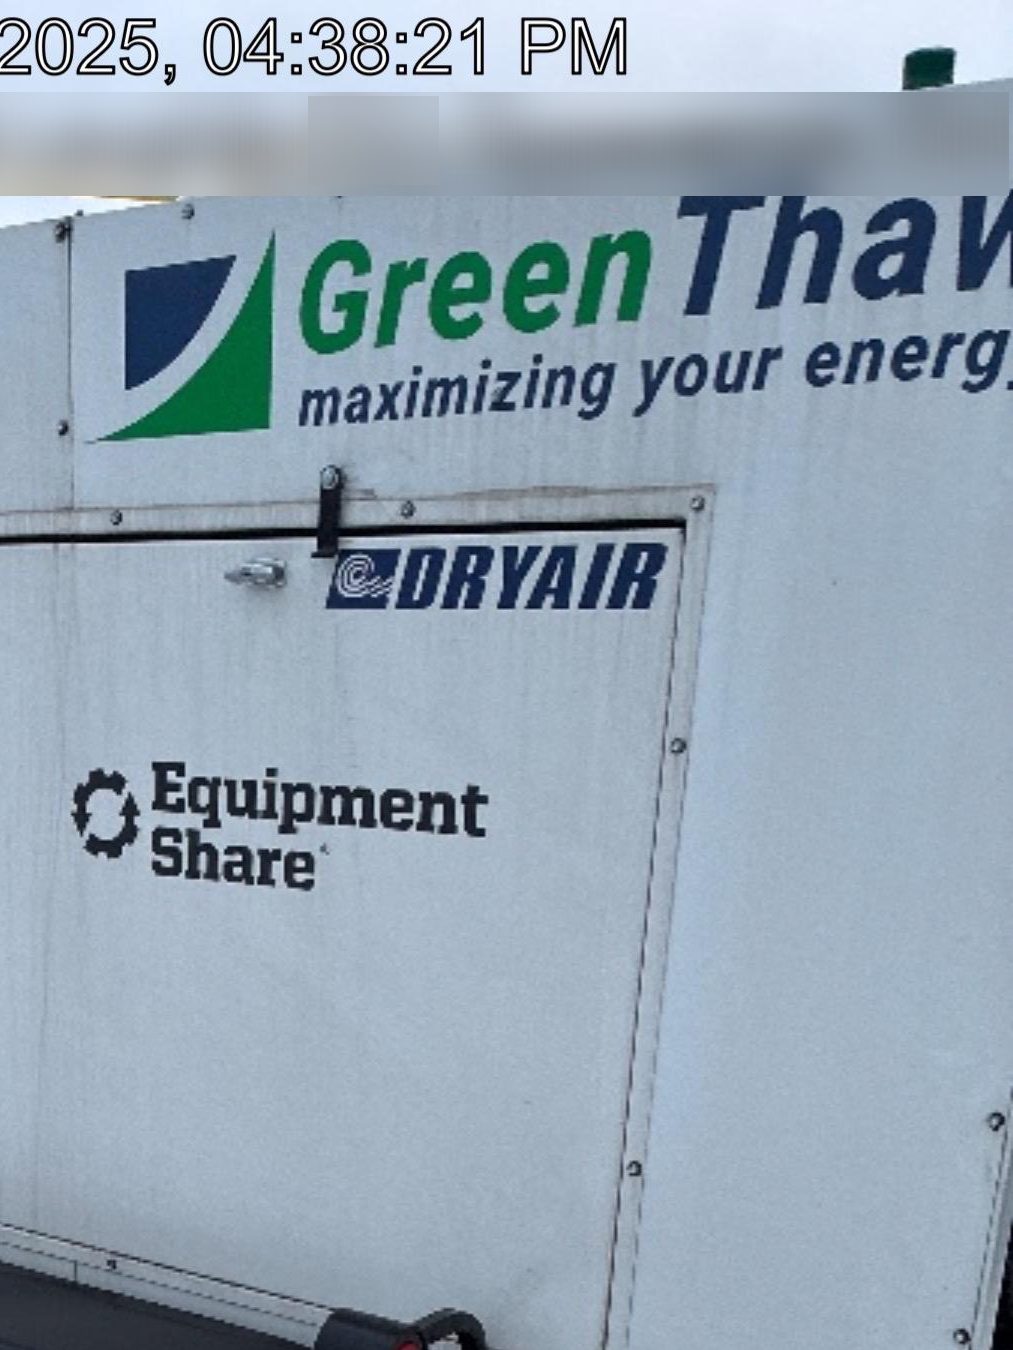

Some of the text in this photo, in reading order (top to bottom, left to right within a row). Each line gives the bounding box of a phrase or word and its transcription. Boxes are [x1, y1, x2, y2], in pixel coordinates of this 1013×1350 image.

[298, 329, 1013, 427] maximizing your energ
[394, 543, 669, 610] DRYAIR
[151, 761, 489, 838] Equipment
[151, 826, 316, 891] Share
